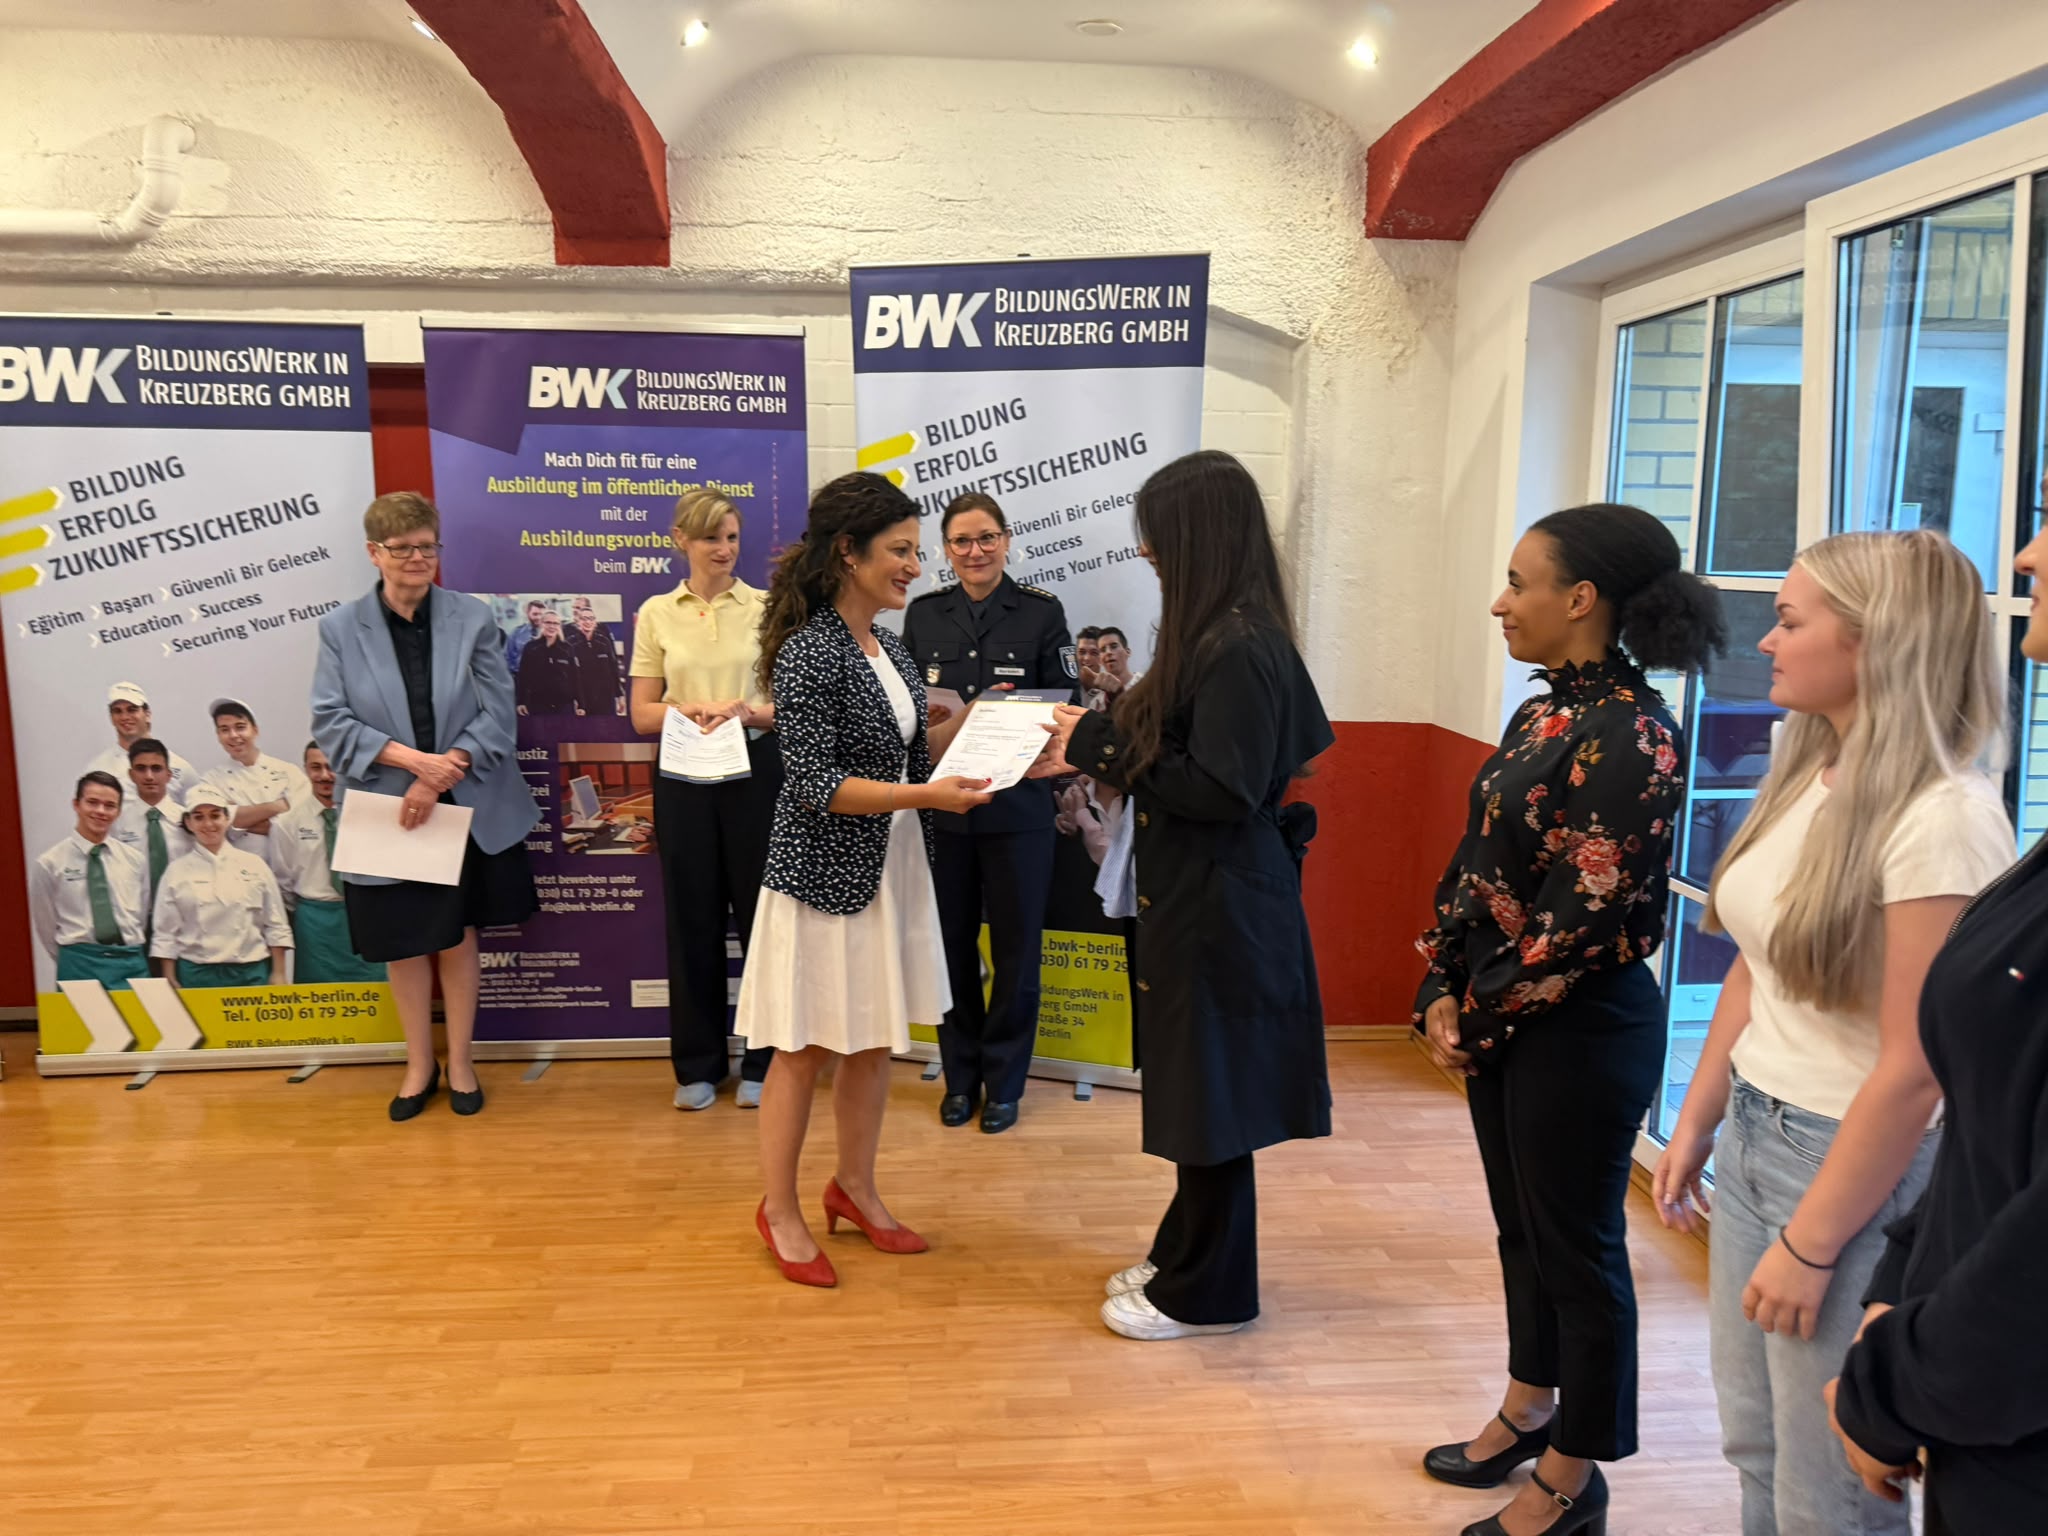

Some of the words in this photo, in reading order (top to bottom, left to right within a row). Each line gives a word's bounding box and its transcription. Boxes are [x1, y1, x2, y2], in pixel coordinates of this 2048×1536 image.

[994, 284, 1161, 314] BILDUNGSWERK
[1167, 285, 1191, 308] IN
[863, 292, 991, 350] BWK
[994, 320, 1113, 347] KREUZBERG
[1121, 319, 1189, 344] GMBH
[136, 345, 319, 374] BILDUNGSWERK
[324, 352, 349, 375] IN
[0, 346, 132, 404] BWK
[636, 369, 765, 392] BILDUNGSWERK
[768, 375, 786, 392] IN
[138, 378, 272, 406] KREUZBERG
[279, 385, 351, 408] GMBH
[528, 366, 633, 409] BWK
[637, 391, 731, 412] KREUZBERG
[736, 396, 787, 413] GMBH
[925, 398, 1027, 447] BILDUNG
[545, 452, 582, 467] Mach
[585, 452, 616, 468] Dich
[620, 453, 637, 468] fit
[641, 453, 663, 469] für
[666, 455, 697, 470] eine
[913, 441, 998, 484] ERFOLG
[69, 456, 186, 503] BILDUNG
[487, 476, 578, 498] Ausbildung
[582, 477, 602, 494] im
[59, 498, 157, 541] ERFOLG
[600, 506, 623, 521] mit
[625, 506, 648, 521] der
[1066, 505, 1087, 522] Bir
[48, 493, 321, 581] ZUKUNFTSSICHERUNG
[1025, 535, 1083, 559] Success
[594, 558, 627, 573] beim
[630, 557, 672, 574] BWK
[1068, 556, 1102, 575] Your
[28, 609, 85, 634] Eğitim
[101, 593, 155, 615] Başarı
[170, 568, 238, 598] Güvenli
[240, 559, 264, 580] Bir
[267, 545, 331, 573] Gelecek
[98, 611, 183, 644] Education
[199, 592, 263, 618] Success
[172, 624, 249, 653] Securing
[249, 613, 286, 640] Your
[609, 875, 637, 884] unter
[562, 888, 575, 898] 61
[578, 888, 591, 898] 79
[620, 888, 644, 898] oder
[1074, 957, 1088, 969] 61
[1093, 958, 1109, 971] 79
[221, 990, 380, 1007] www.bwk-berlin.de
[1063, 1001, 1098, 1013] GmbH
[1112, 990, 1124, 1001] in
[223, 1009, 250, 1022] Tel.
[255, 1006, 294, 1022] (030)
[299, 1007, 314, 1019] 61
[320, 1007, 336, 1019] 79
[341, 1005, 377, 1018] 29-0
[1071, 1016, 1085, 1027] 34
[1039, 1026, 1071, 1039] Berlin
